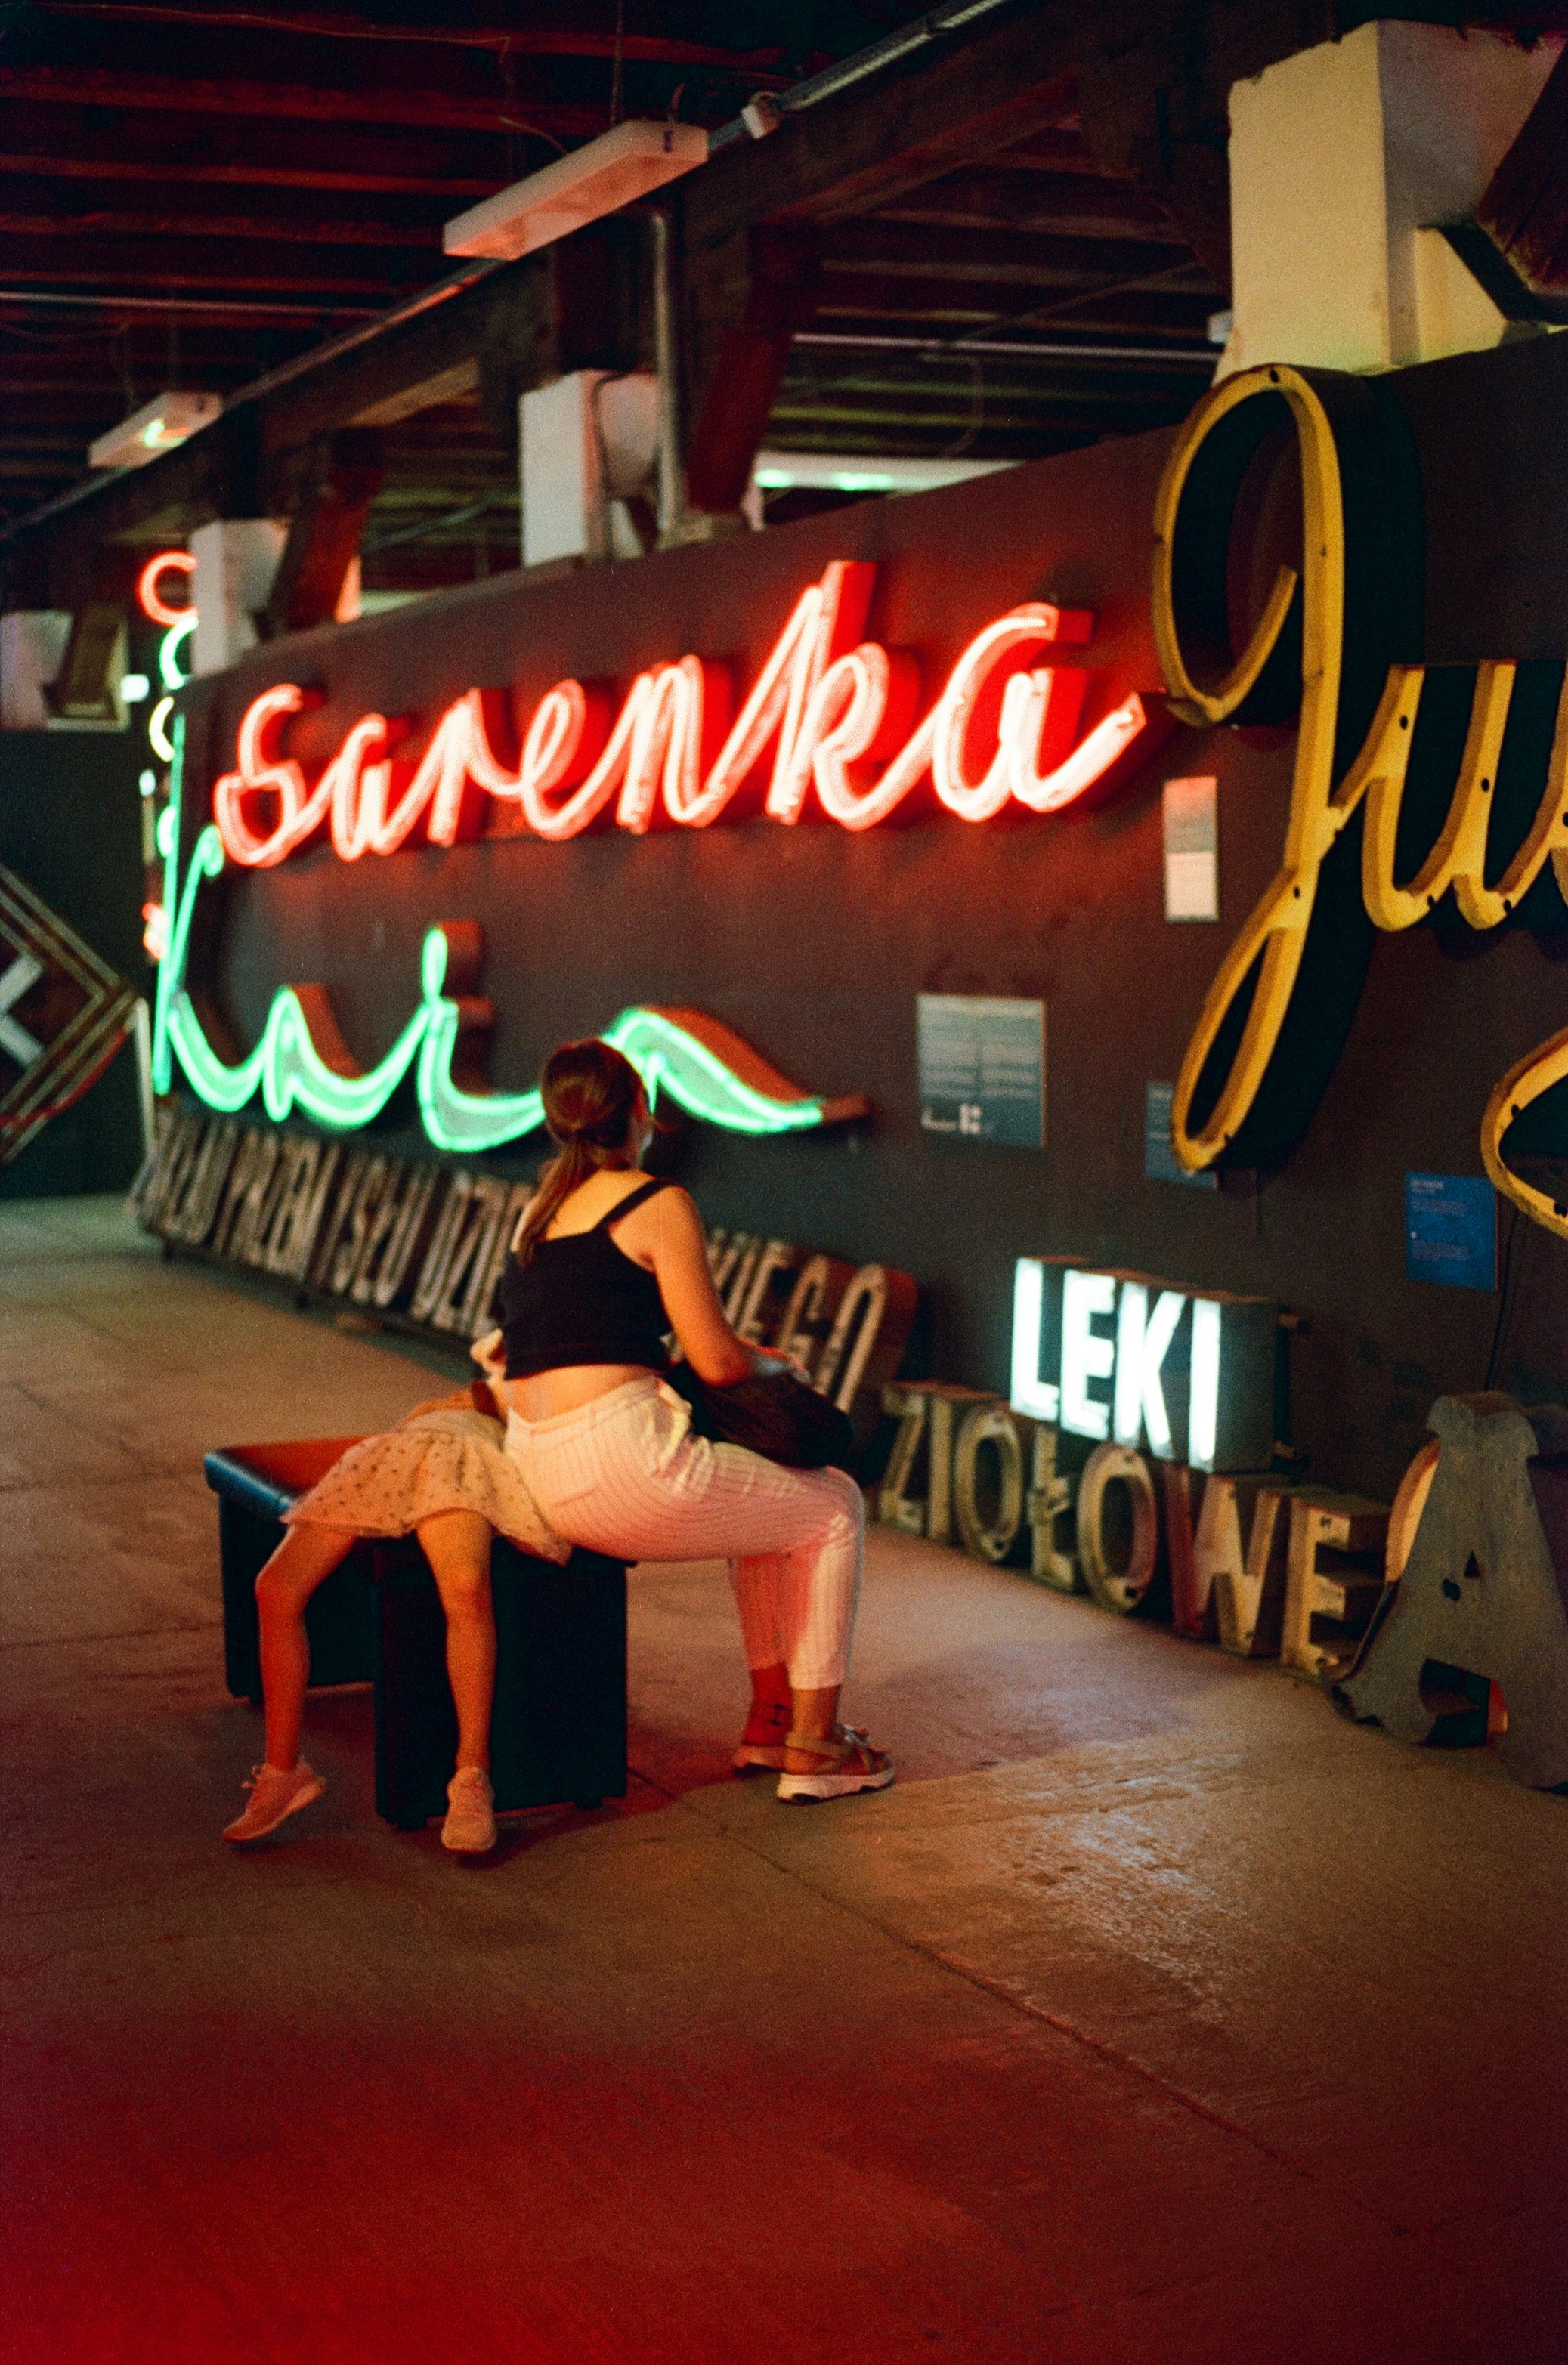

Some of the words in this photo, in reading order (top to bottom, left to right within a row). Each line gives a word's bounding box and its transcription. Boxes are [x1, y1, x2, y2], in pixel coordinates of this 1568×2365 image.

[215, 561, 1147, 867] Sarenka
[1153, 364, 1568, 1176] Ju
[1010, 1255, 1223, 1473] LEKI
